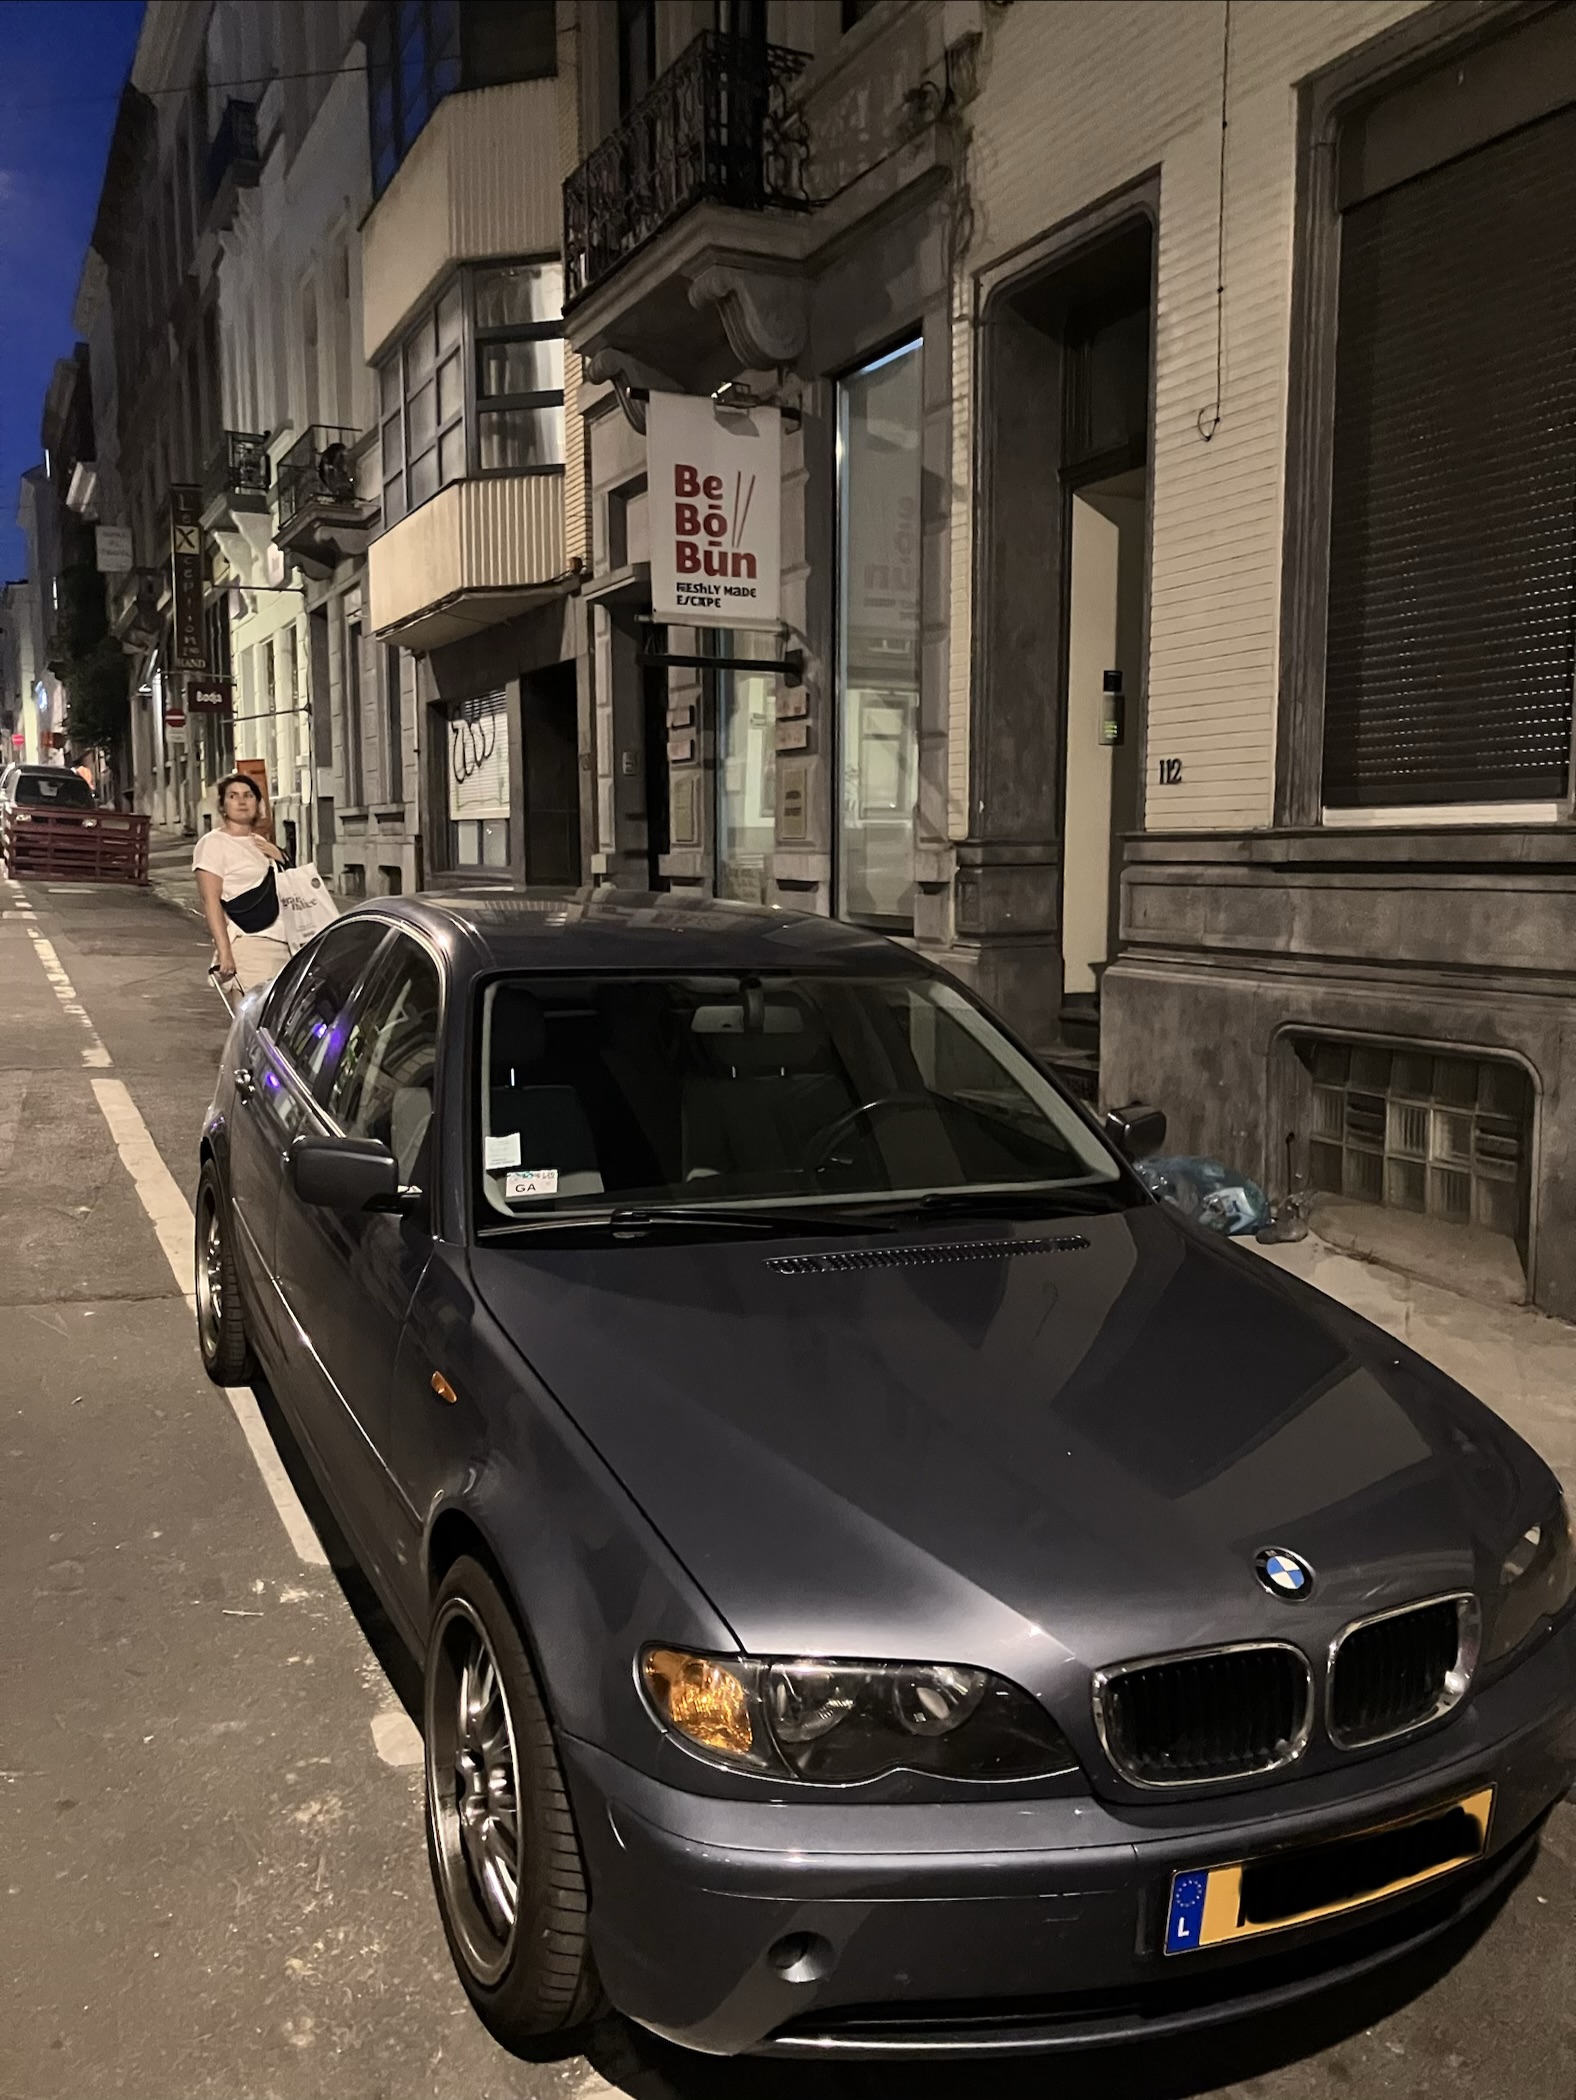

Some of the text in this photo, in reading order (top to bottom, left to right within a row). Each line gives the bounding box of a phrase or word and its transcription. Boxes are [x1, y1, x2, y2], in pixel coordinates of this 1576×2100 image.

[675, 464, 723, 500] Be
[1159, 758, 1182, 785] 112
[515, 1183, 536, 1193] GA
[1178, 1917, 1190, 1938] L
